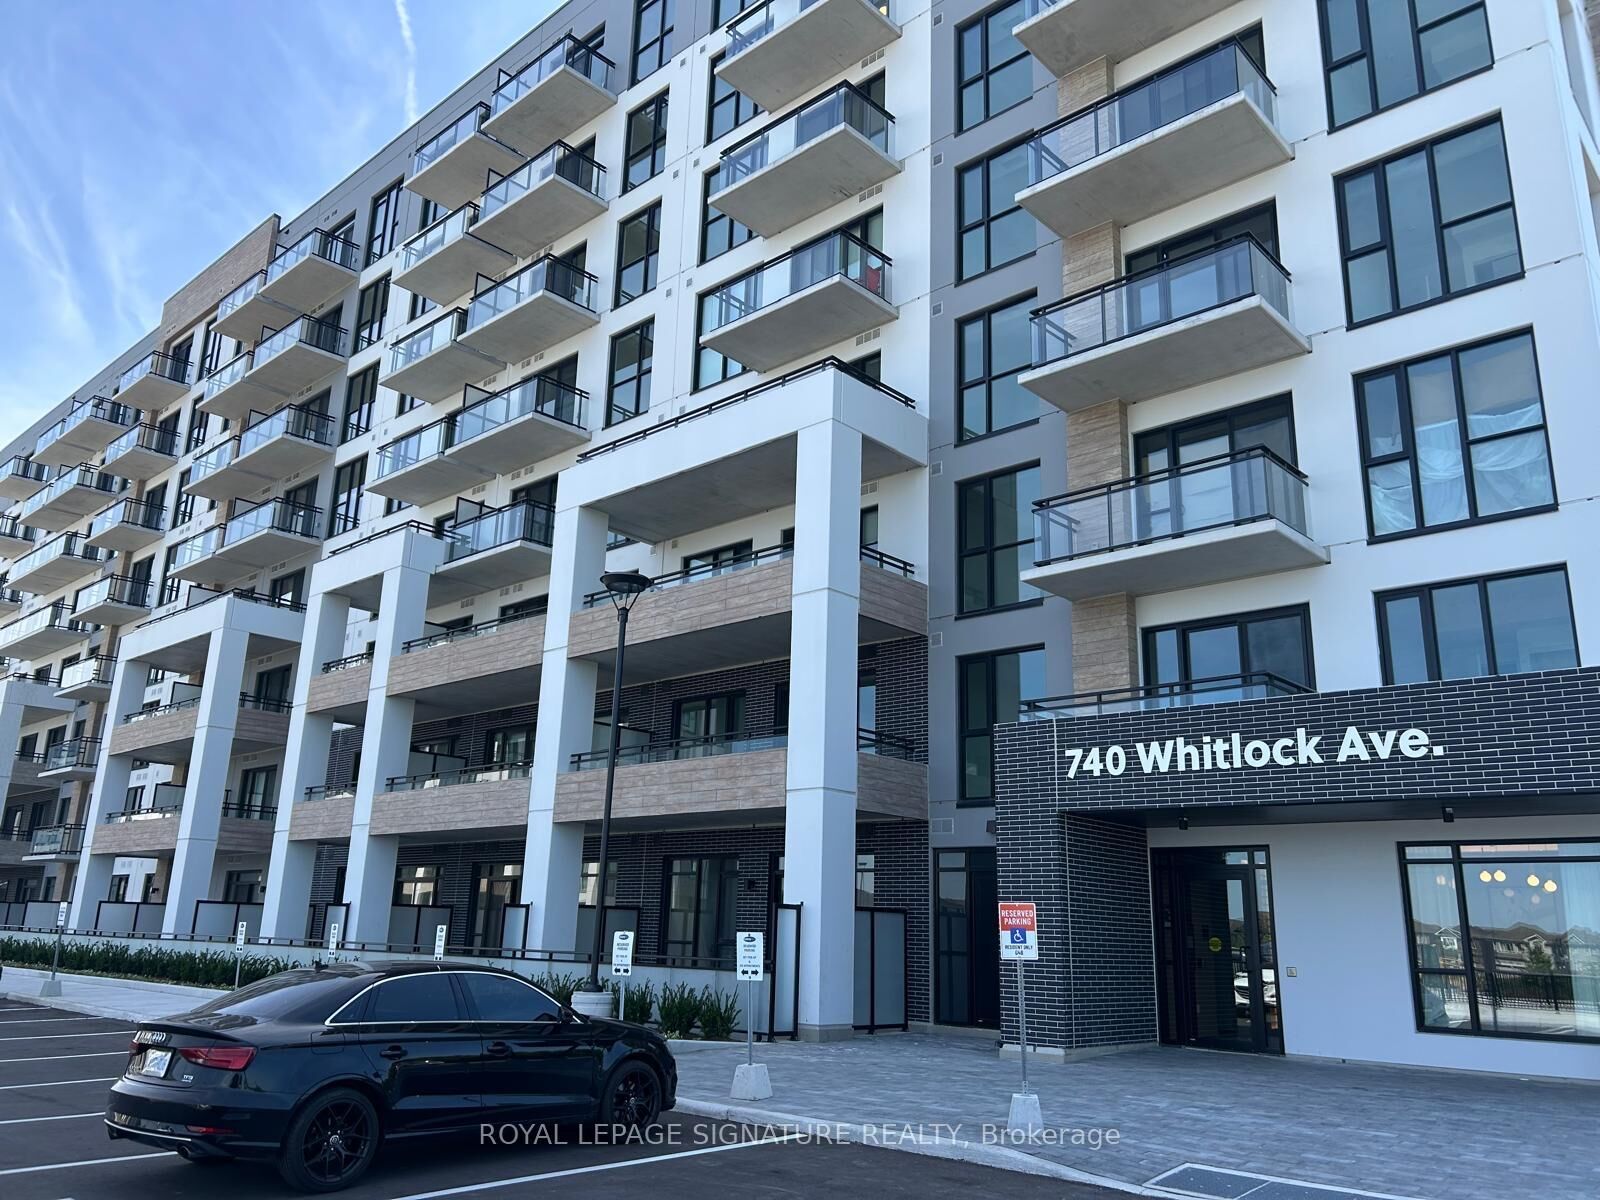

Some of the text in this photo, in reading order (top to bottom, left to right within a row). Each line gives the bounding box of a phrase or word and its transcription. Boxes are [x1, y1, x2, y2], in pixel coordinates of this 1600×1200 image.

[1065, 726, 1444, 779] 740 Whitlock Ave.
[1004, 917, 1031, 925] PARKING
